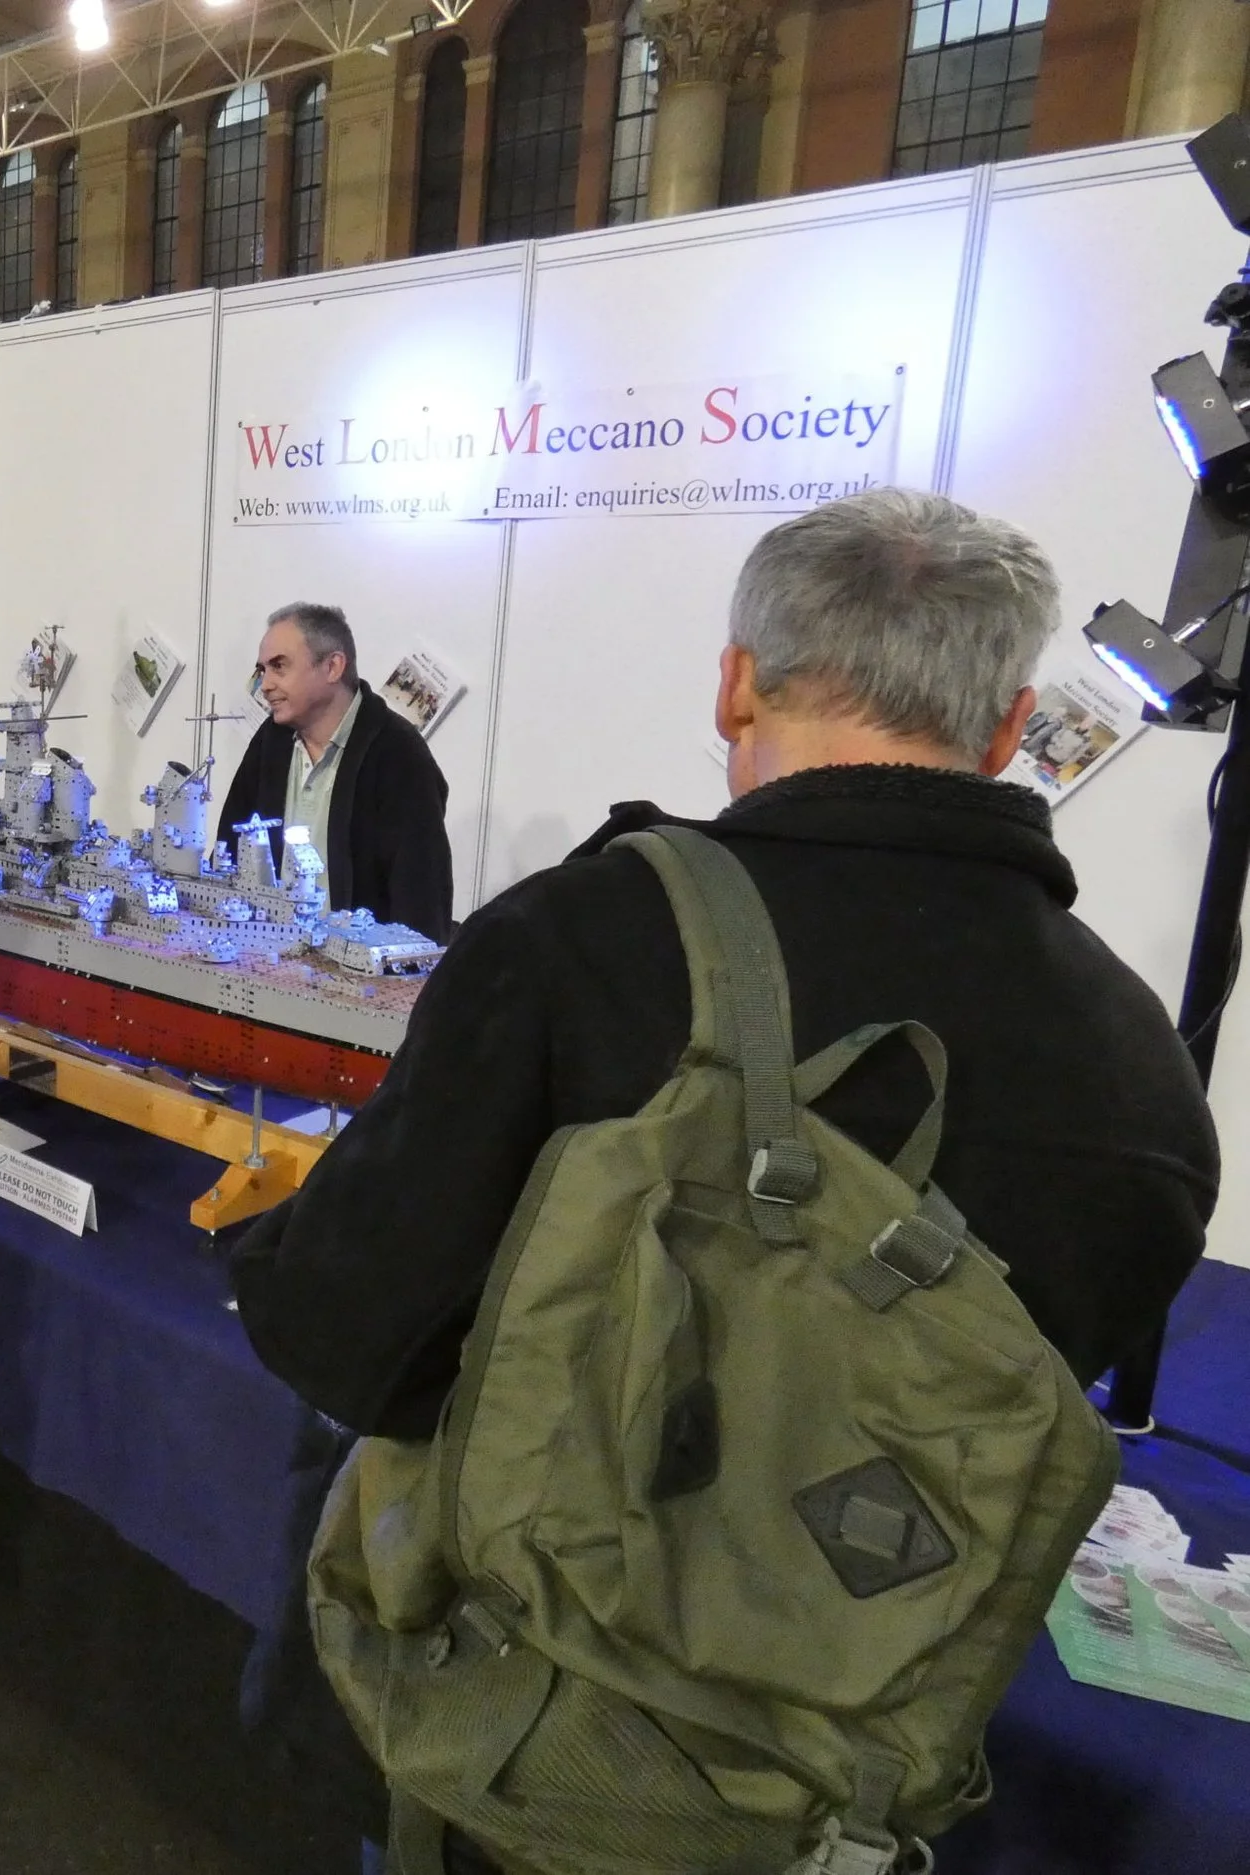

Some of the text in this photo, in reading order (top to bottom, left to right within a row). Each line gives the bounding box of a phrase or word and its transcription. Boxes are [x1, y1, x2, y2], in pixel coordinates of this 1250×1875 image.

[242, 423, 326, 471] West
[489, 402, 684, 456] Meccano
[700, 386, 891, 448] Society
[238, 473, 879, 518] Web: www.wlms.org.uk Email: enquiries@wlms.org.uk
[22, 1182, 34, 1194] DO
[35, 1187, 52, 1201] NOT
[52, 1195, 79, 1216] TOUCH
[51, 1207, 78, 1226] SYSTEMS
